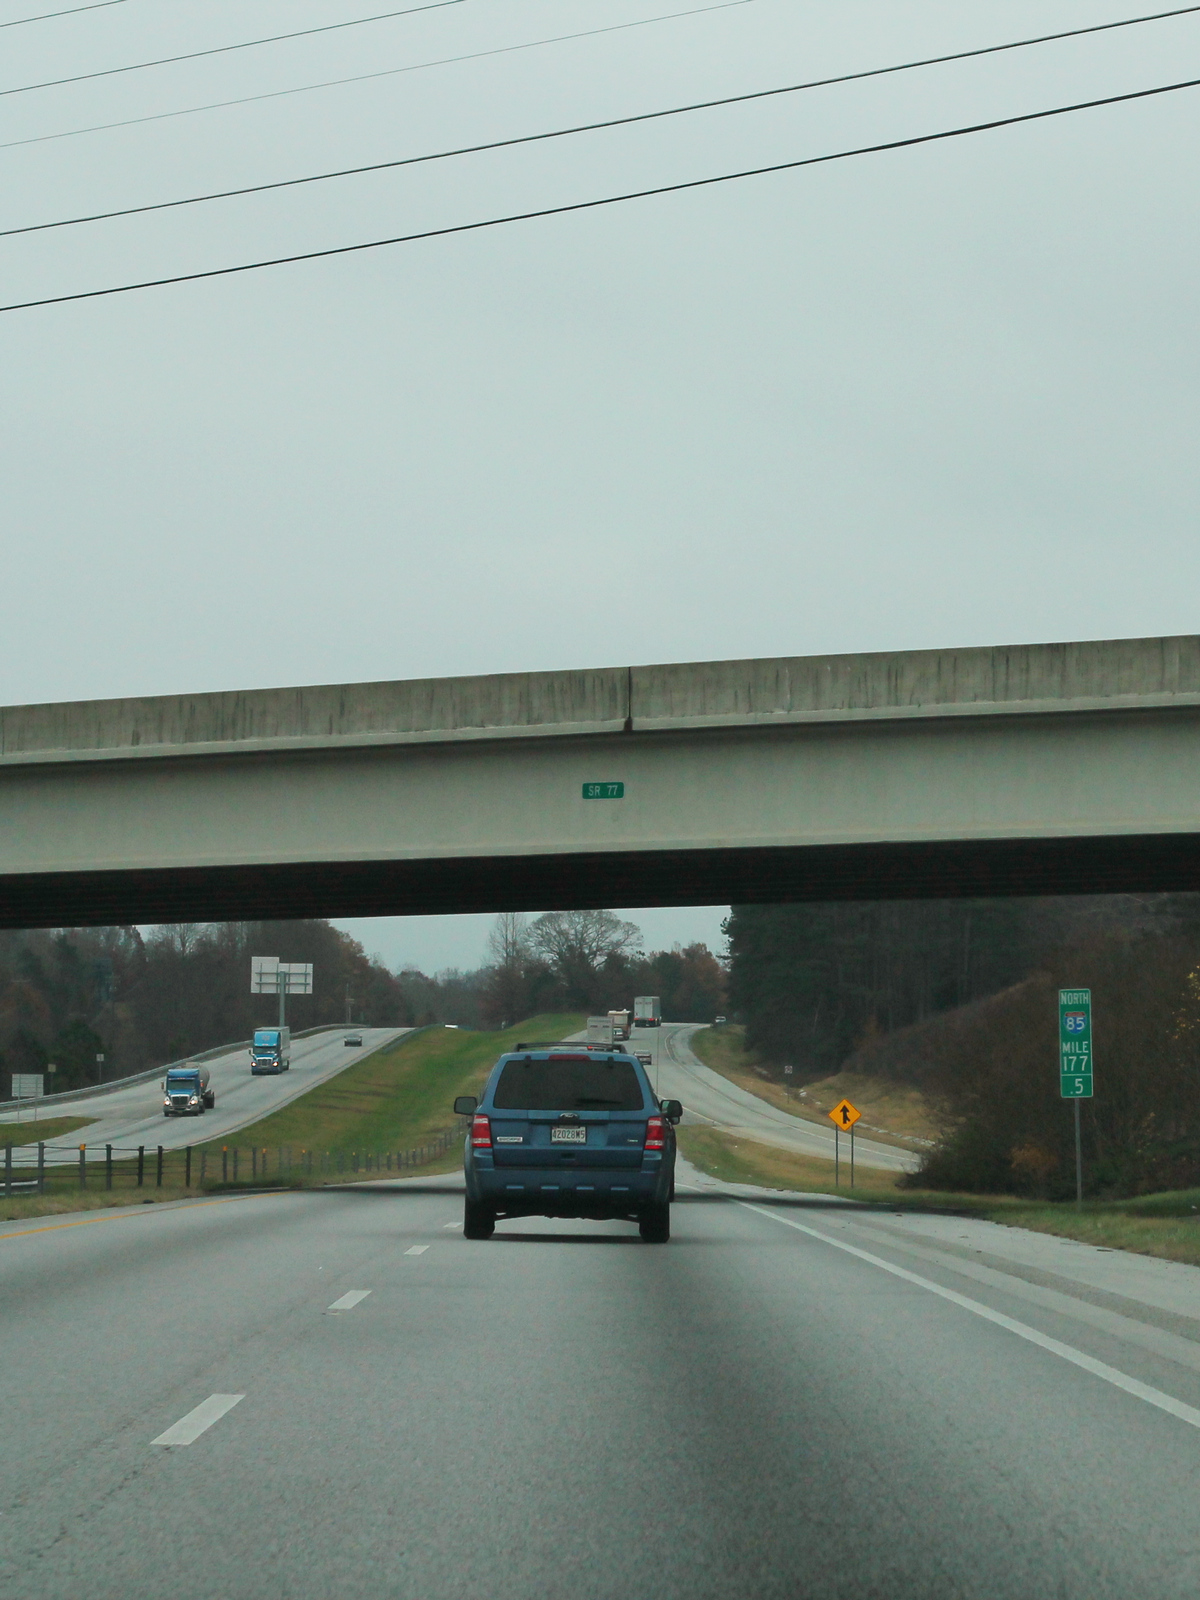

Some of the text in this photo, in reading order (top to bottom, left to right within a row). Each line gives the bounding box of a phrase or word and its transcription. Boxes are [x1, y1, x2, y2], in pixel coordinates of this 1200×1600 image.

[588, 785, 618, 796] SR 77
[1060, 993, 1089, 1005] NORTH
[1066, 1018, 1085, 1030] 85
[1062, 1042, 1089, 1053] MILE
[1063, 1056, 1088, 1071] 177
